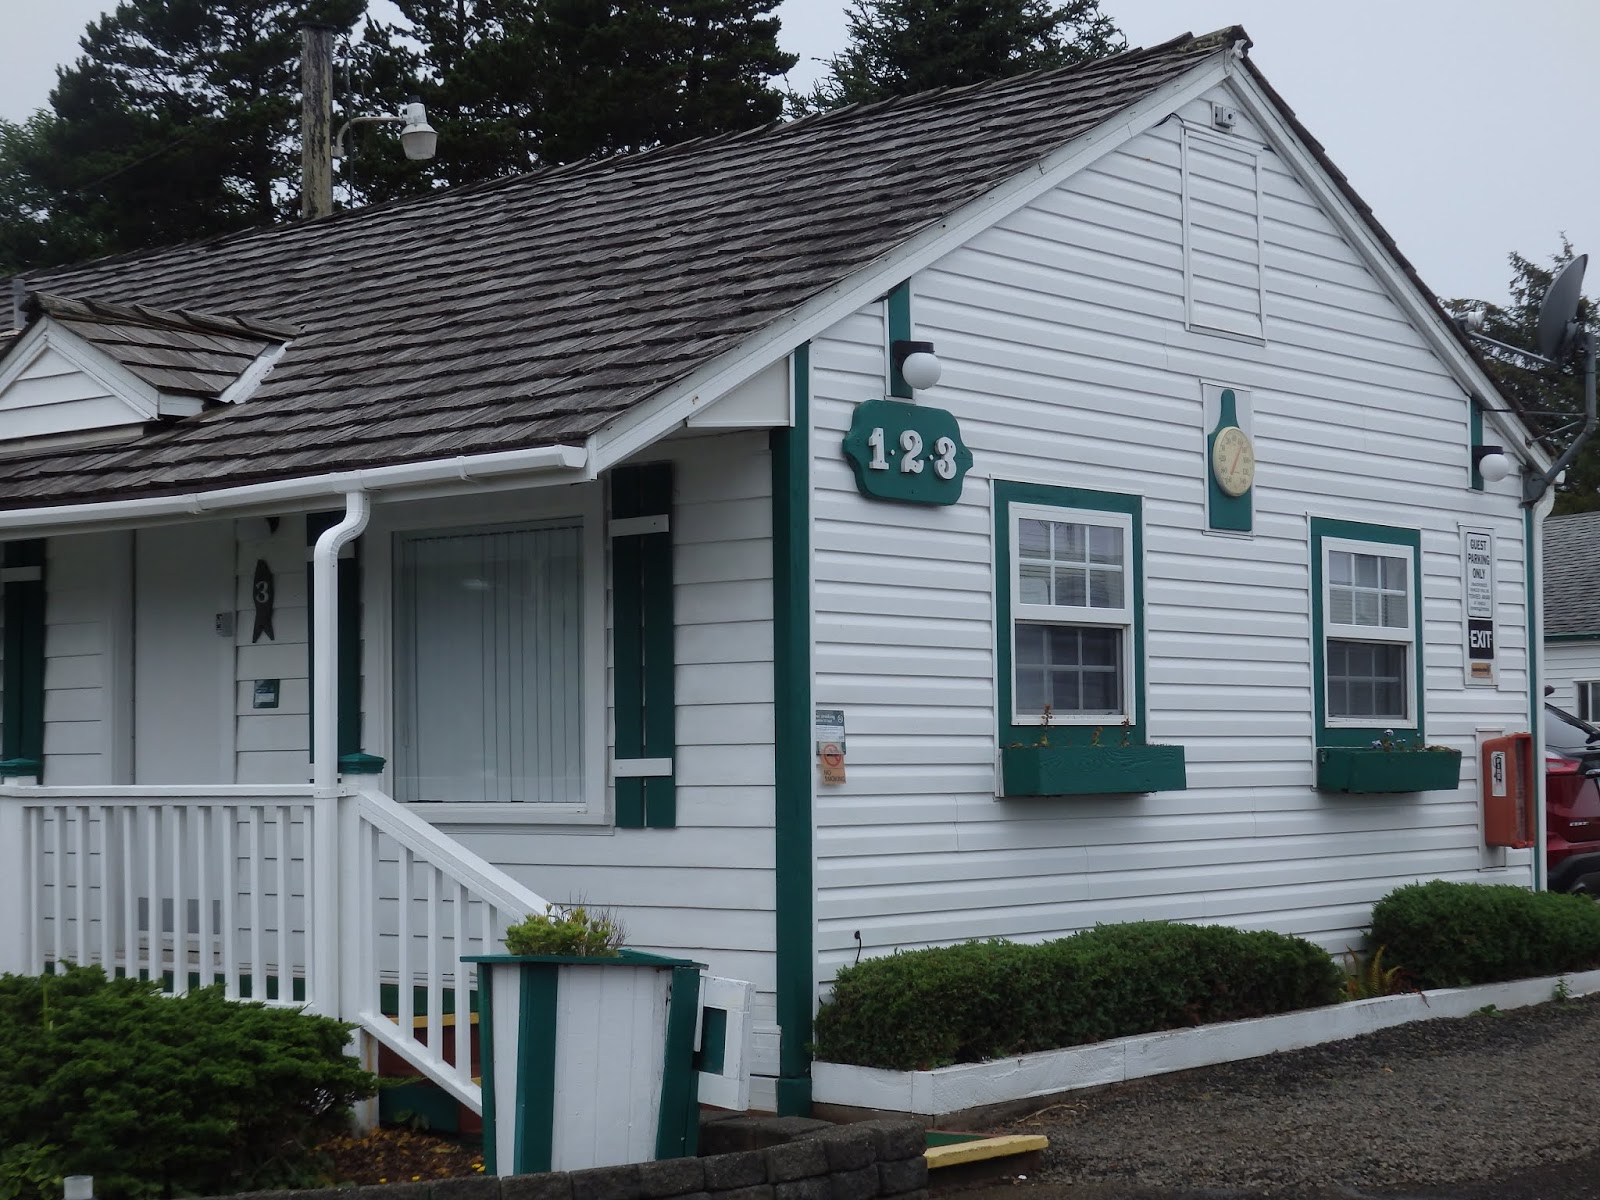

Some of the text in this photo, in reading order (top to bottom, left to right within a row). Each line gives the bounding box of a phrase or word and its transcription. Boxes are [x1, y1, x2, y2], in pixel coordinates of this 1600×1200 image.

[1470, 539, 1487, 550] GUEST
[1468, 553, 1490, 565] PARKING
[1472, 568, 1486, 579] ONLY
[255, 580, 269, 603] 3
[1470, 629, 1492, 648] EXIT
